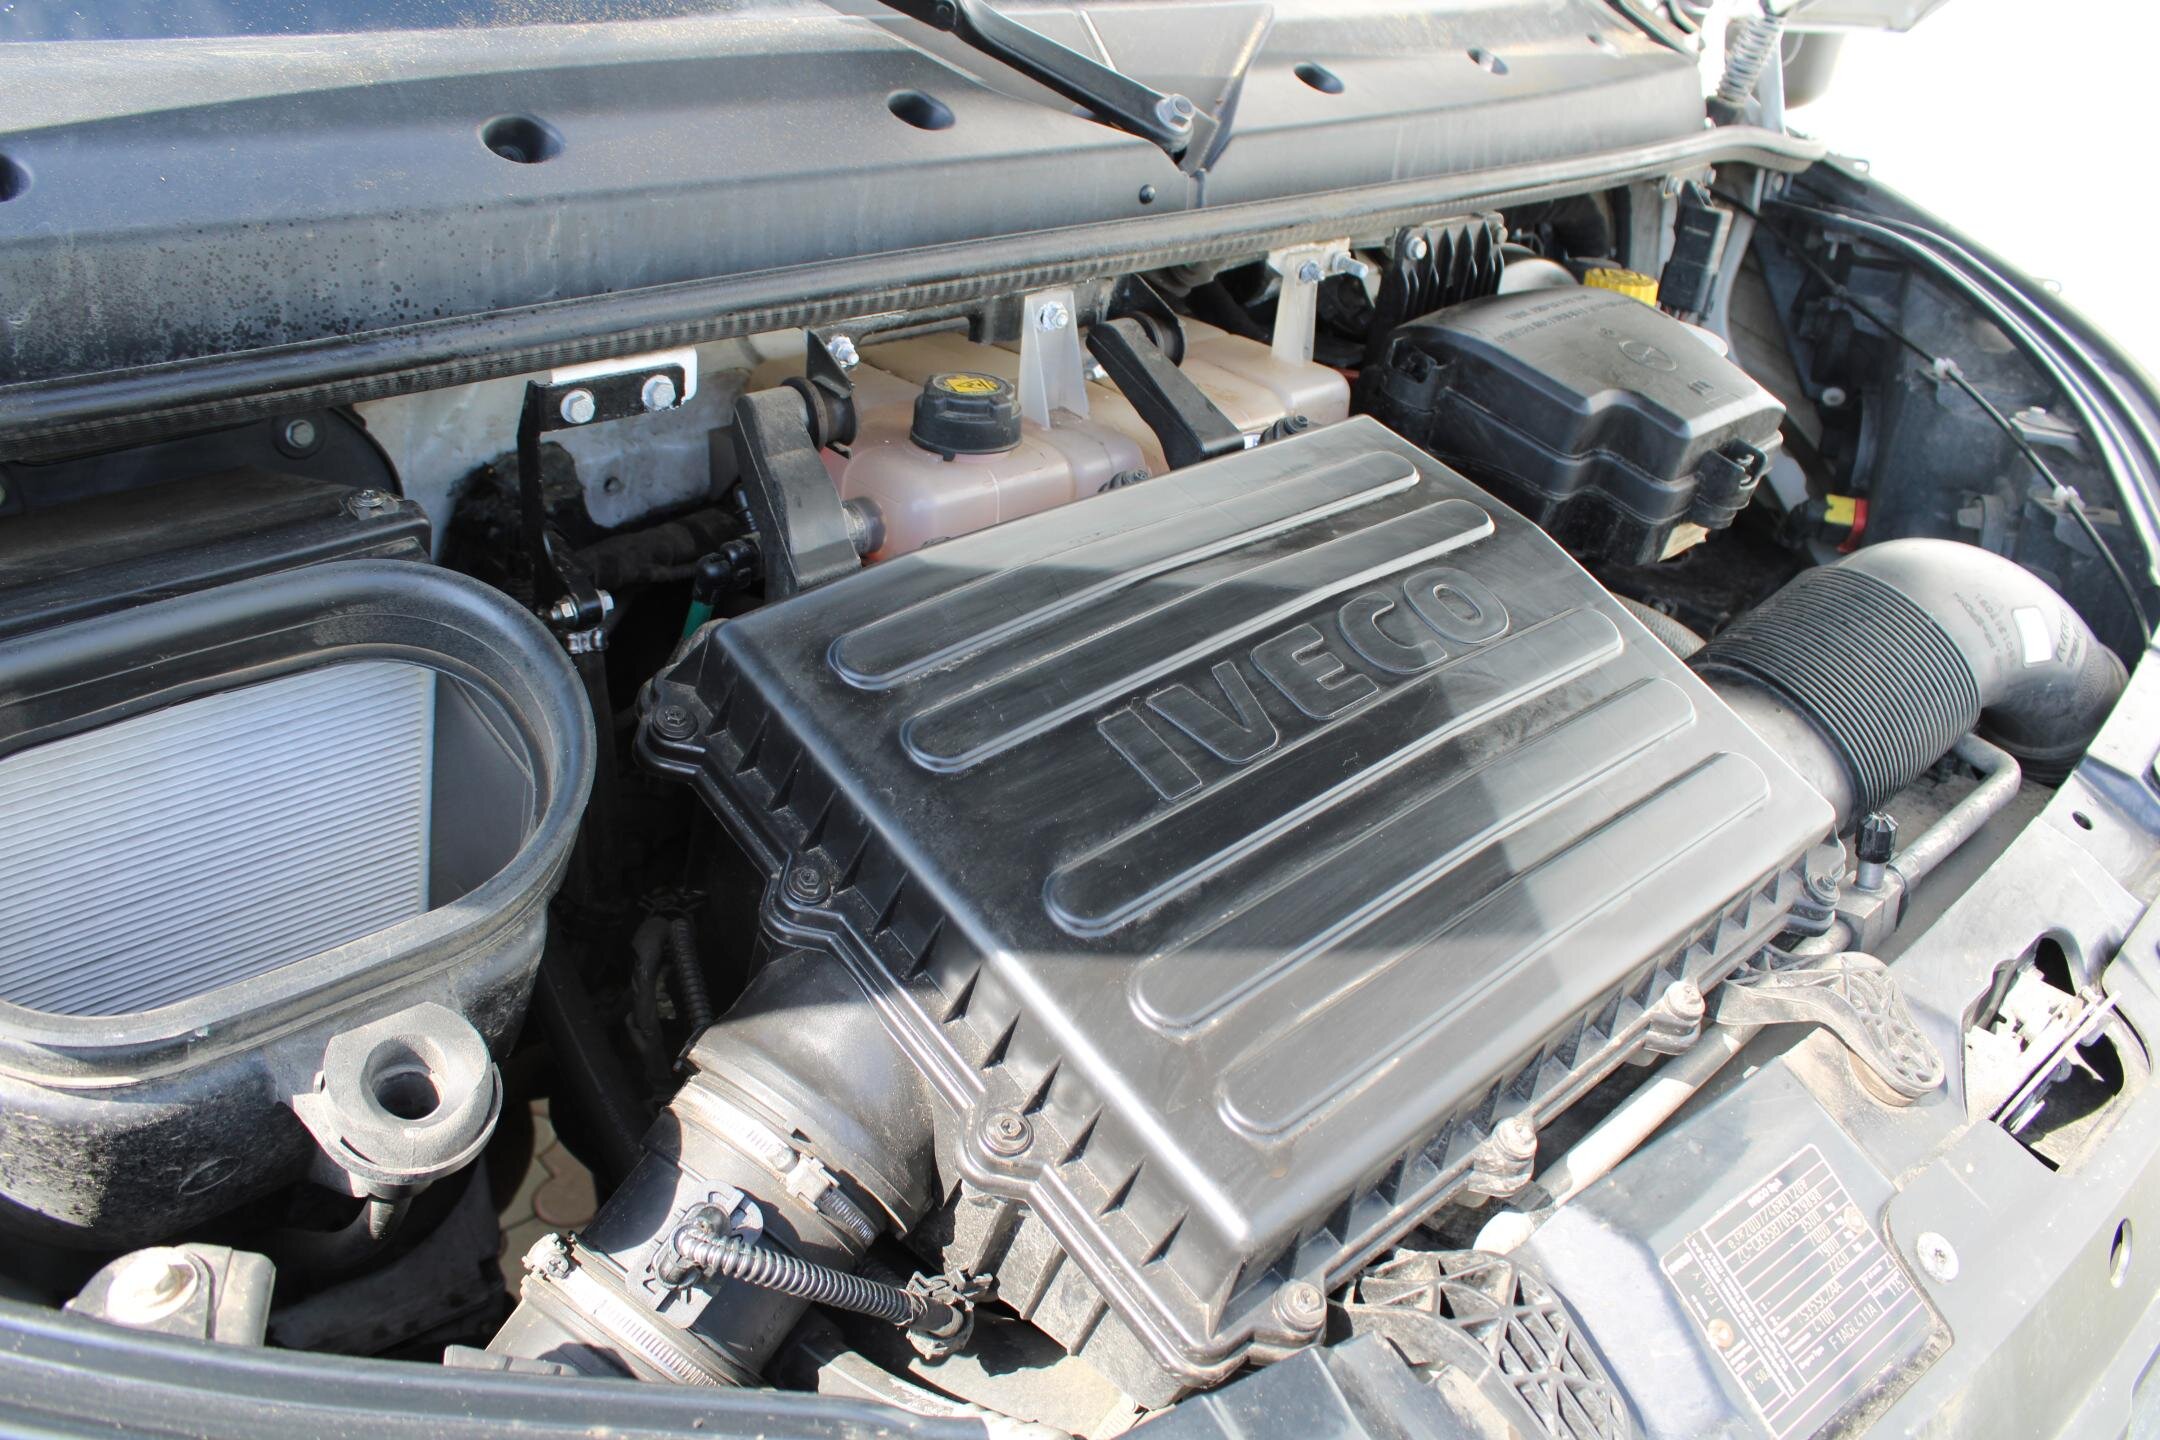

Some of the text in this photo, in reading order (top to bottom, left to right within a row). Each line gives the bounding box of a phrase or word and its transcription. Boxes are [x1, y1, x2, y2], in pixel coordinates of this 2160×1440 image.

[1097, 567, 1510, 801] IVECO
[1797, 1209, 1822, 1234] 3500
[1692, 1269, 1724, 1314] ITALY
